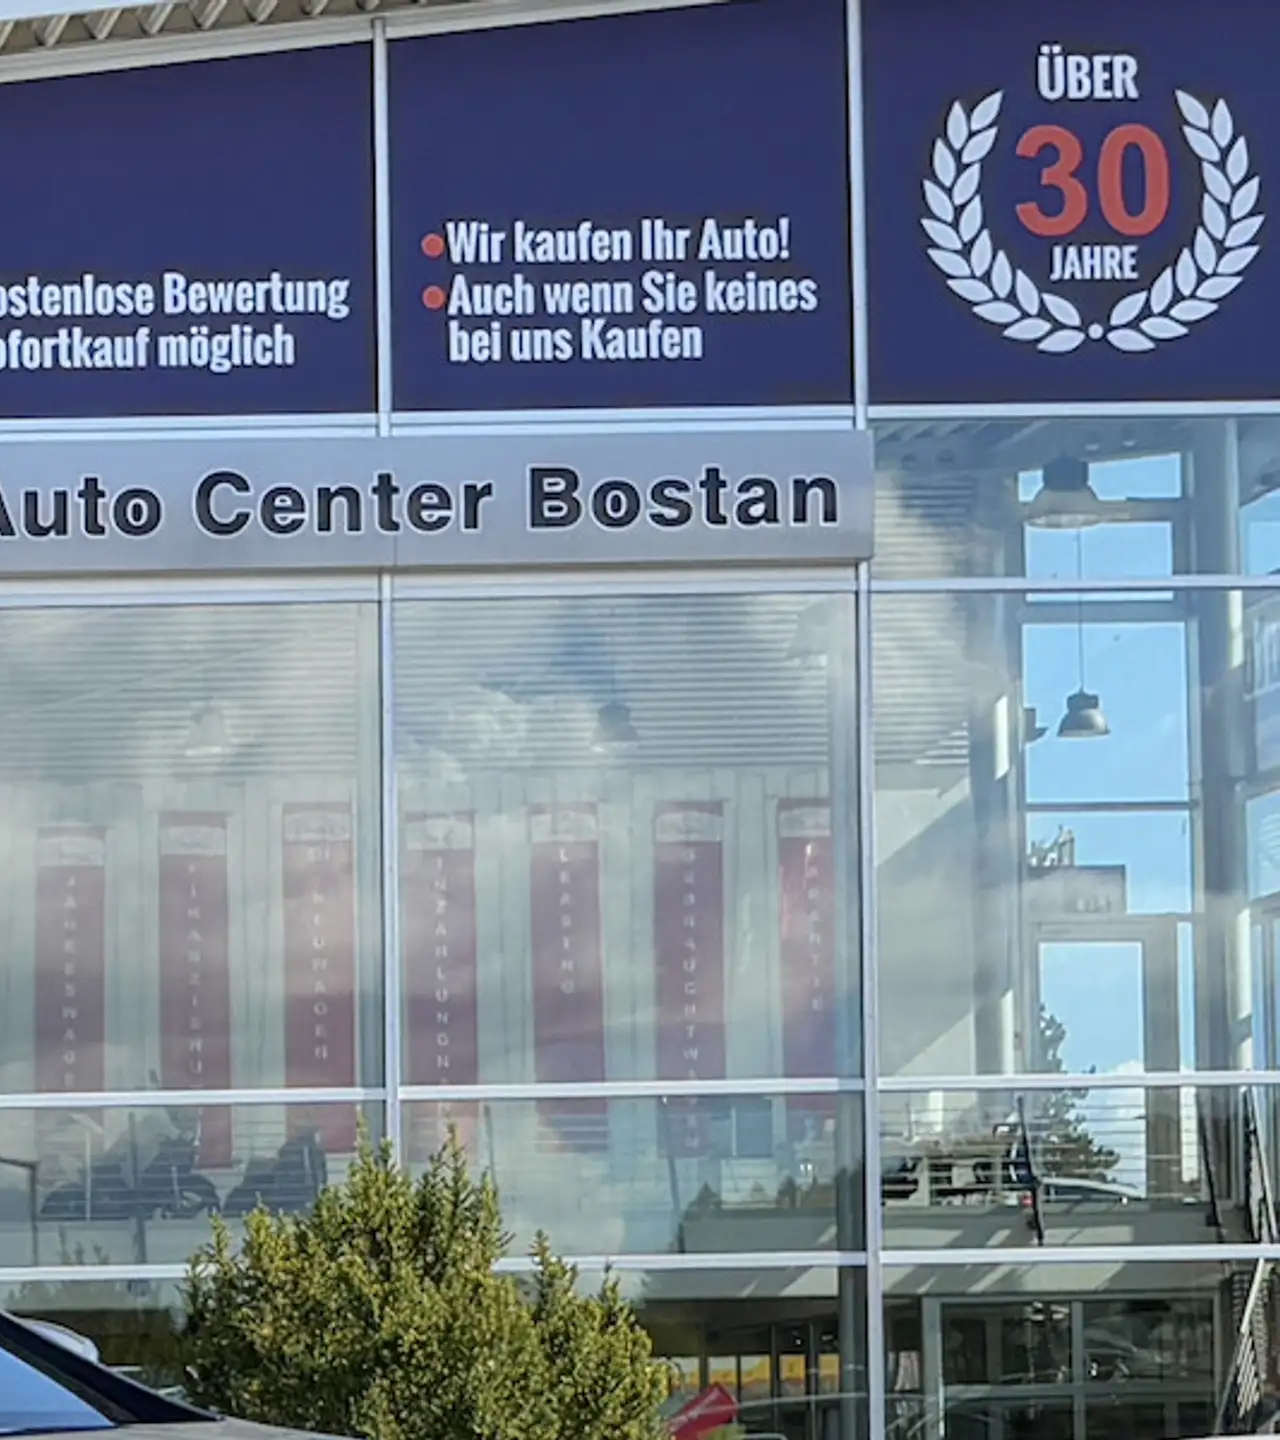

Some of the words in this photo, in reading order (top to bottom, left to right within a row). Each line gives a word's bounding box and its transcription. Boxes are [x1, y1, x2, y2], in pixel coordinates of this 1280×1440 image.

[1037, 44, 1140, 100] ÜBER
[1015, 122, 1171, 237] 30
[446, 221, 506, 264] Wir
[514, 220, 632, 263] kaufen
[641, 218, 691, 261] Ihr
[698, 217, 789, 260] Auto!
[1049, 245, 1139, 281] JAHRE
[163, 271, 350, 319] Bewertung
[447, 273, 535, 316] Auch
[543, 281, 634, 314] wenn
[642, 270, 697, 313] Sie
[705, 270, 818, 312] keines
[158, 323, 295, 373] möglich
[449, 319, 501, 362] bei
[511, 328, 573, 361] uns
[581, 317, 703, 360] Kaufen
[194, 470, 494, 536] Center
[529, 466, 838, 529] Bostan
[61, 873, 78, 1090] JAHRESWAGE
